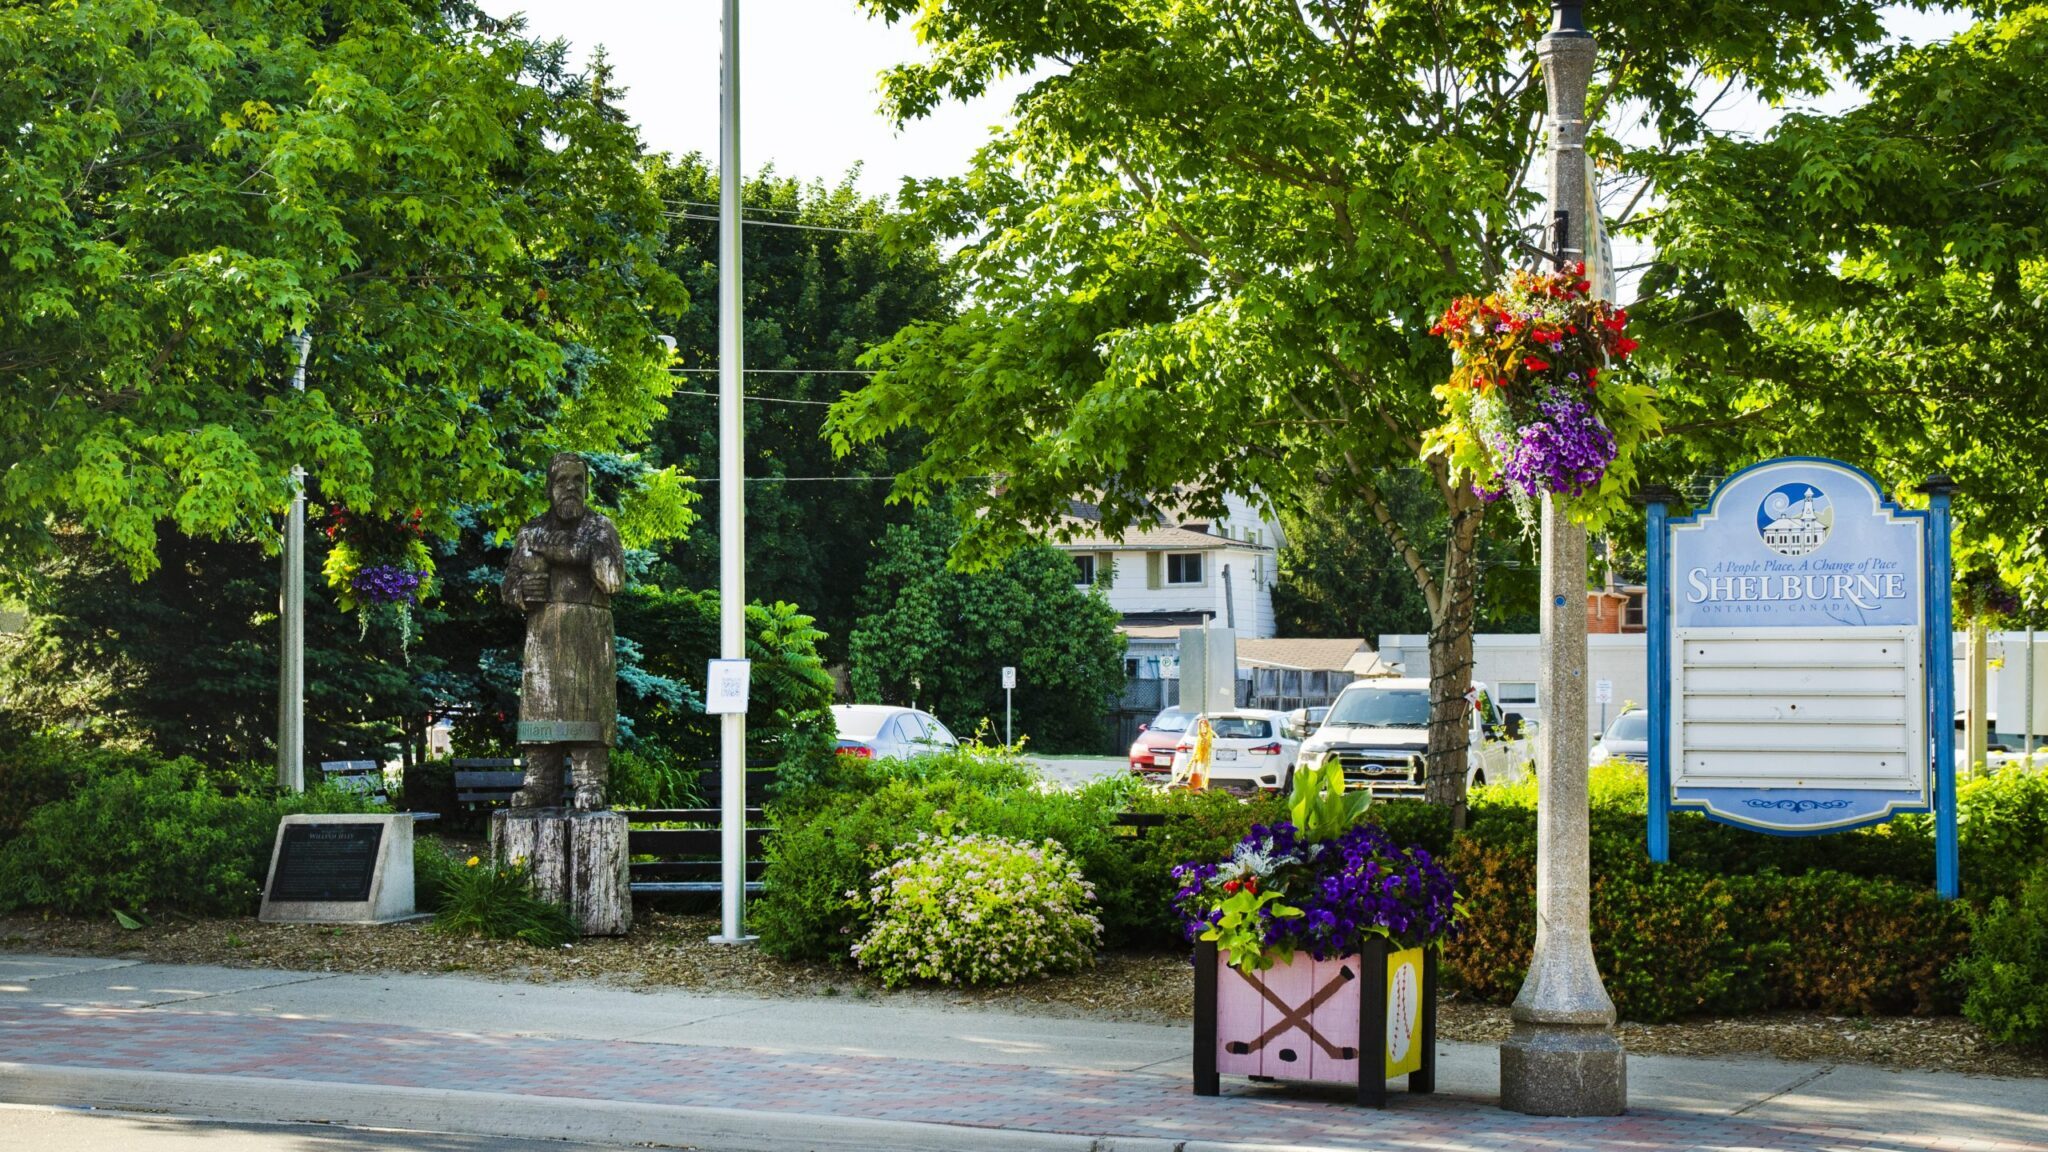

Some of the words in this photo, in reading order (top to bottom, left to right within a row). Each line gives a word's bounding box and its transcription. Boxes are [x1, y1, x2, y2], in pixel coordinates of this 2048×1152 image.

[1713, 561, 1722, 572] A
[1726, 560, 1760, 575] People
[1763, 559, 1795, 572] Place,
[1798, 559, 1808, 571] A
[1812, 558, 1855, 574] Change
[1857, 557, 1872, 573] of
[1872, 558, 1898, 570] Pace
[1685, 566, 1907, 611] SHELBURNE
[1788, 602, 1851, 612] CANADA
